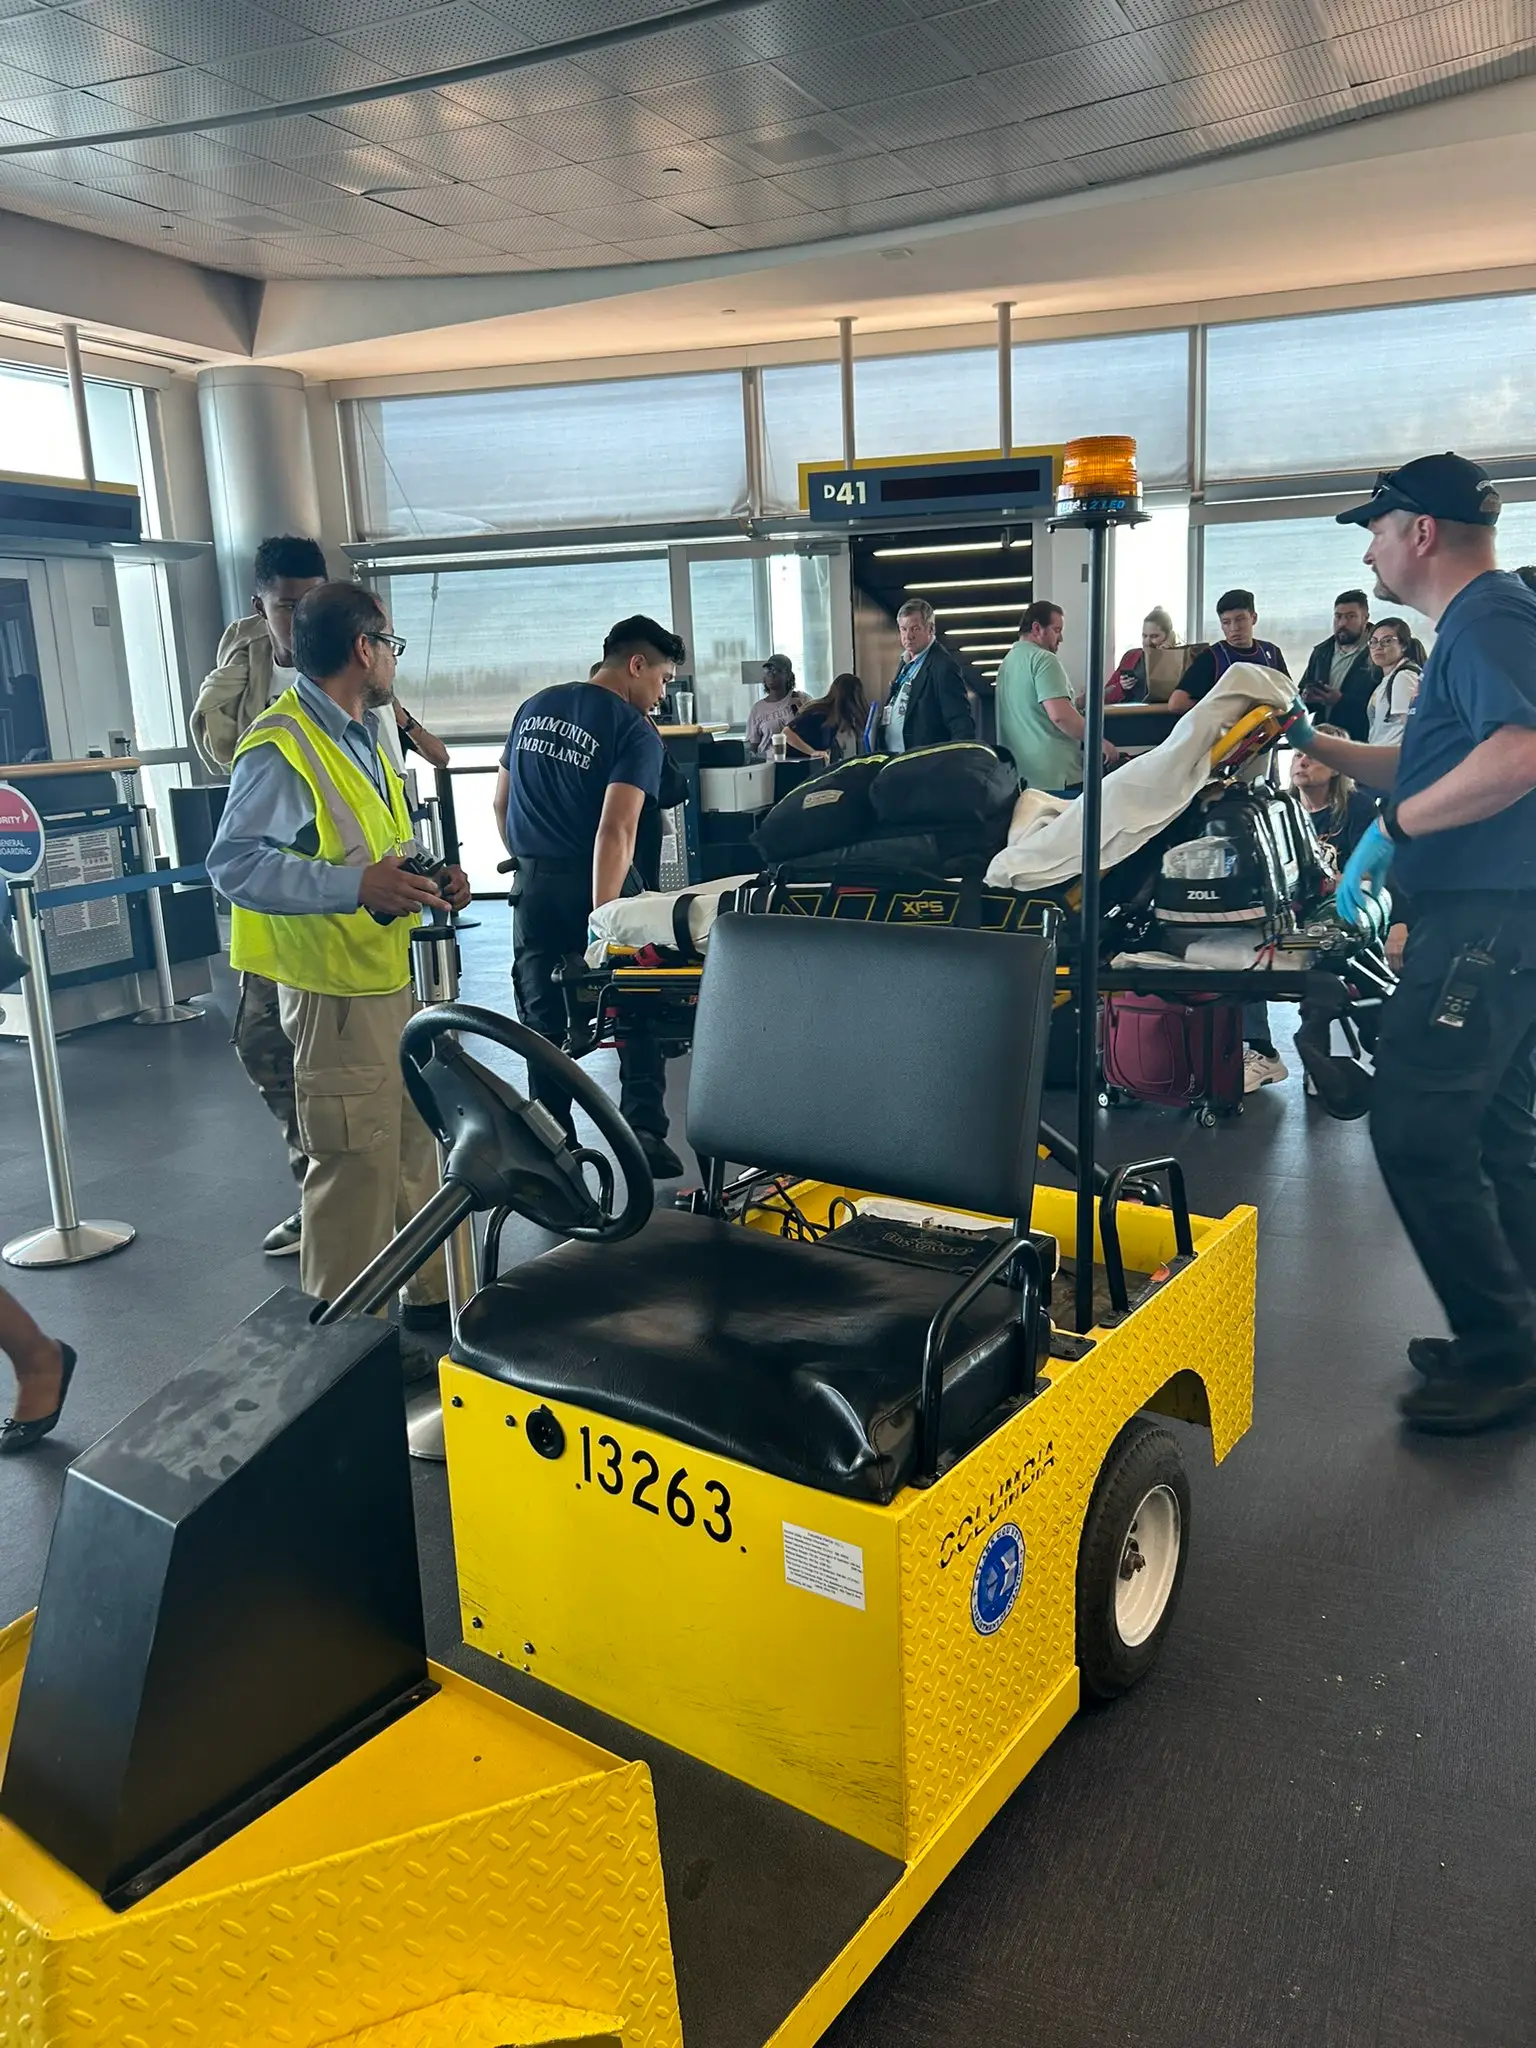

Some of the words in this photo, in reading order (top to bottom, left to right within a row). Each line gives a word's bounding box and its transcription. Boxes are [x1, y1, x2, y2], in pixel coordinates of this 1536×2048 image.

[824, 481, 866, 505] D41
[519, 716, 600, 757] COMMUNITY
[902, 901, 944, 915] XPS
[1187, 890, 1220, 900] ZOLL
[579, 1426, 733, 1543] 13263
[938, 1440, 1055, 1569] COLUMBIA
